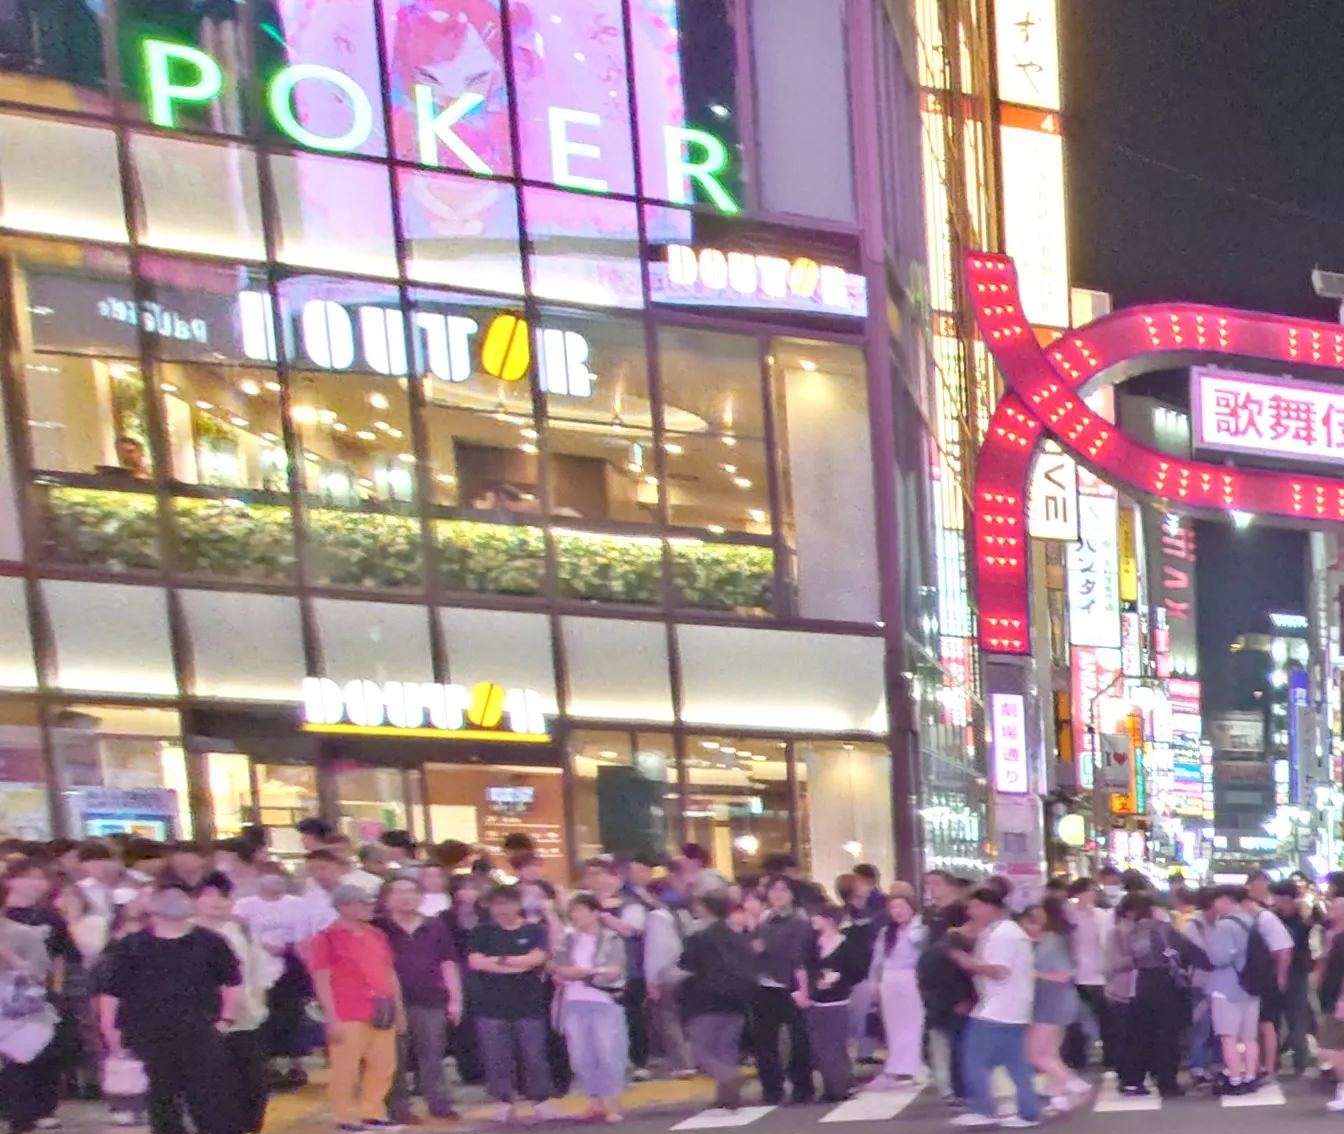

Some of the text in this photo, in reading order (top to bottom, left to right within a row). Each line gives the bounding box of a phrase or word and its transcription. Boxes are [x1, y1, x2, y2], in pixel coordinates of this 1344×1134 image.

[143, 38, 741, 215] POKER
[667, 244, 848, 304] DOUTOR
[239, 290, 593, 397] DOUTOR
[301, 677, 546, 734] DOUTOR
